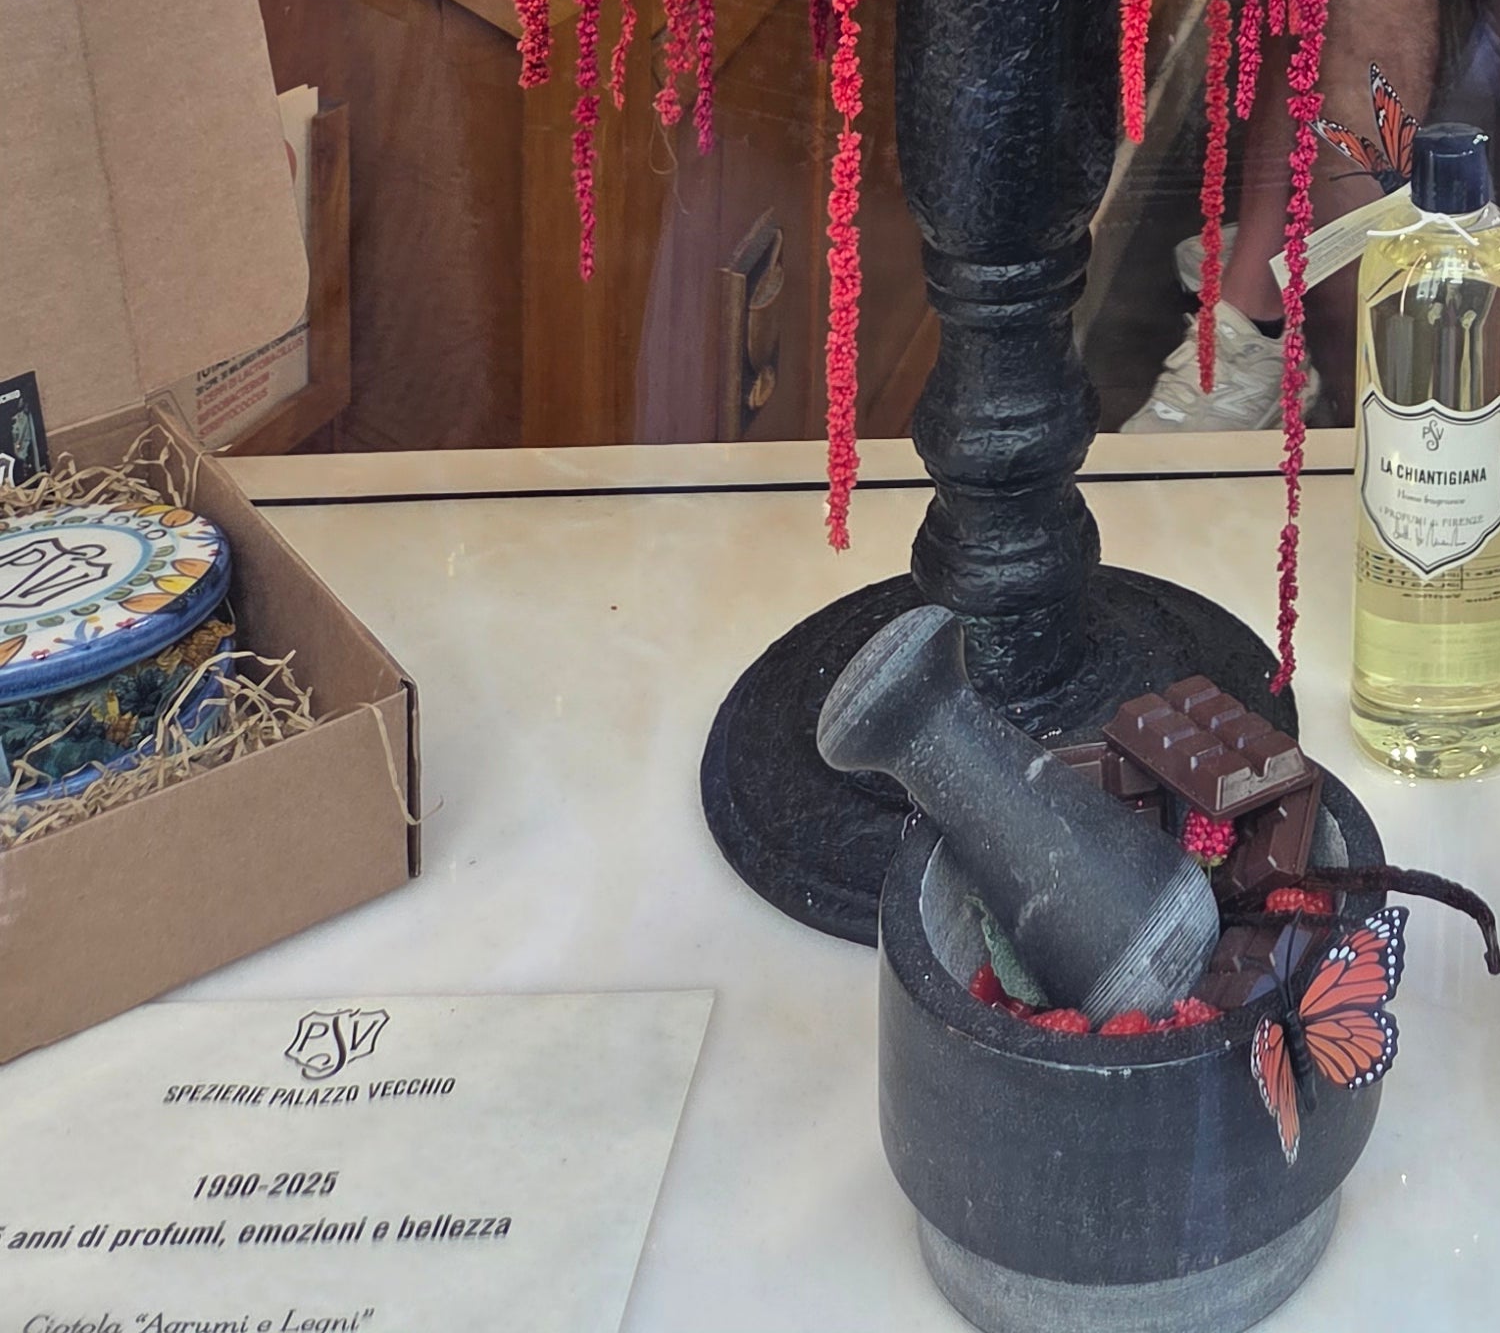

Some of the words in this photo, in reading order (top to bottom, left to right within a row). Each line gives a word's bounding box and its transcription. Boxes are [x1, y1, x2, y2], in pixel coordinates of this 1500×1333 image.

[1380, 457, 1394, 476] LA
[1397, 464, 1487, 486] CHIANTIGIANA
[1384, 507, 1427, 528] PROFUMI
[1441, 514, 1485, 527] FIRENZE
[163, 1083, 270, 1108] SPEZIERIE
[268, 1084, 360, 1108] PALAZZO
[368, 1077, 456, 1101] VECCHIO
[193, 1170, 339, 1200] 1990-2025
[8, 1224, 75, 1250] anni
[77, 1223, 109, 1249] di
[108, 1220, 226, 1253] profumi,
[238, 1215, 368, 1245] emozioni
[371, 1220, 391, 1241] e
[396, 1213, 512, 1242] bellezza
[22, 1312, 123, 1333] Ciotola
[257, 1319, 273, 1333] e
